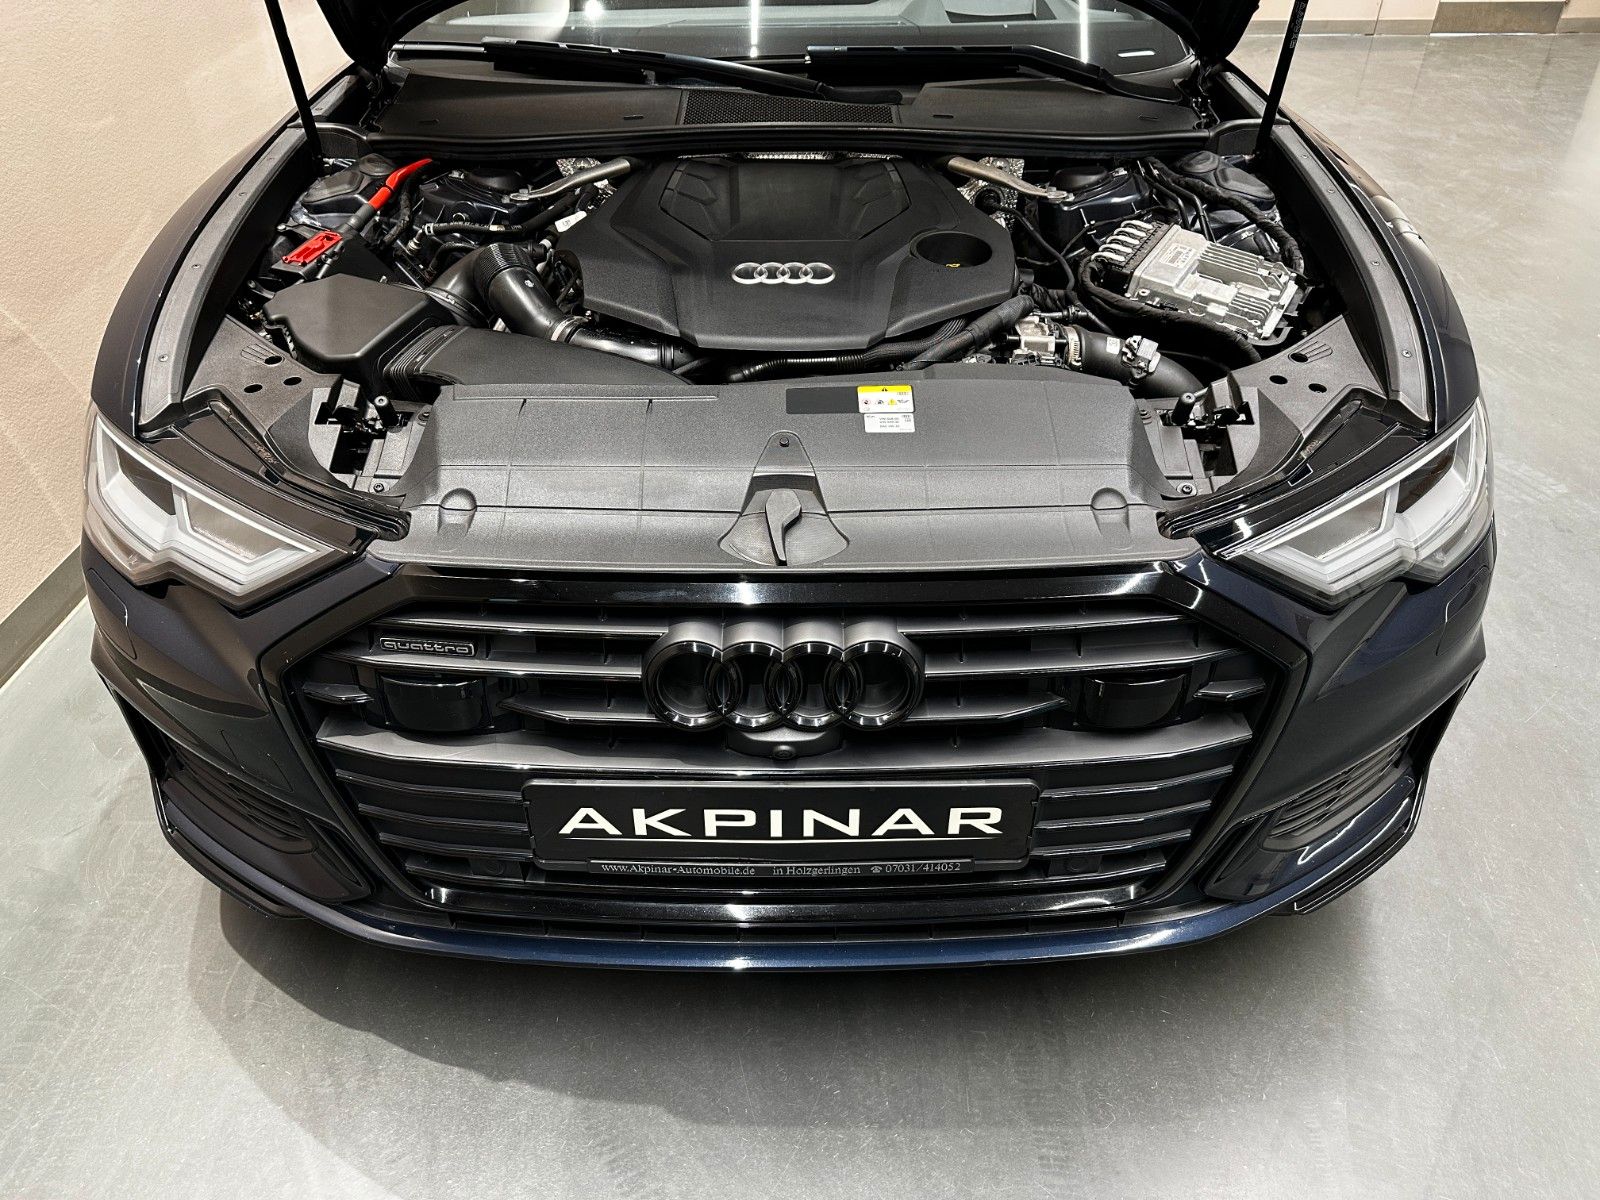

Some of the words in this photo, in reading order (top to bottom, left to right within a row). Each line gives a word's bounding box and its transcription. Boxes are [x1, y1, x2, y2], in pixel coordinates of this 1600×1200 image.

[383, 641, 469, 653] quattro
[559, 807, 1002, 837] AKPINAR
[601, 863, 755, 876] www.Akpinar-Automobile.de
[772, 865, 783, 876] in
[786, 864, 861, 876] Holzgerlingen
[885, 862, 961, 873] 07031/414052
